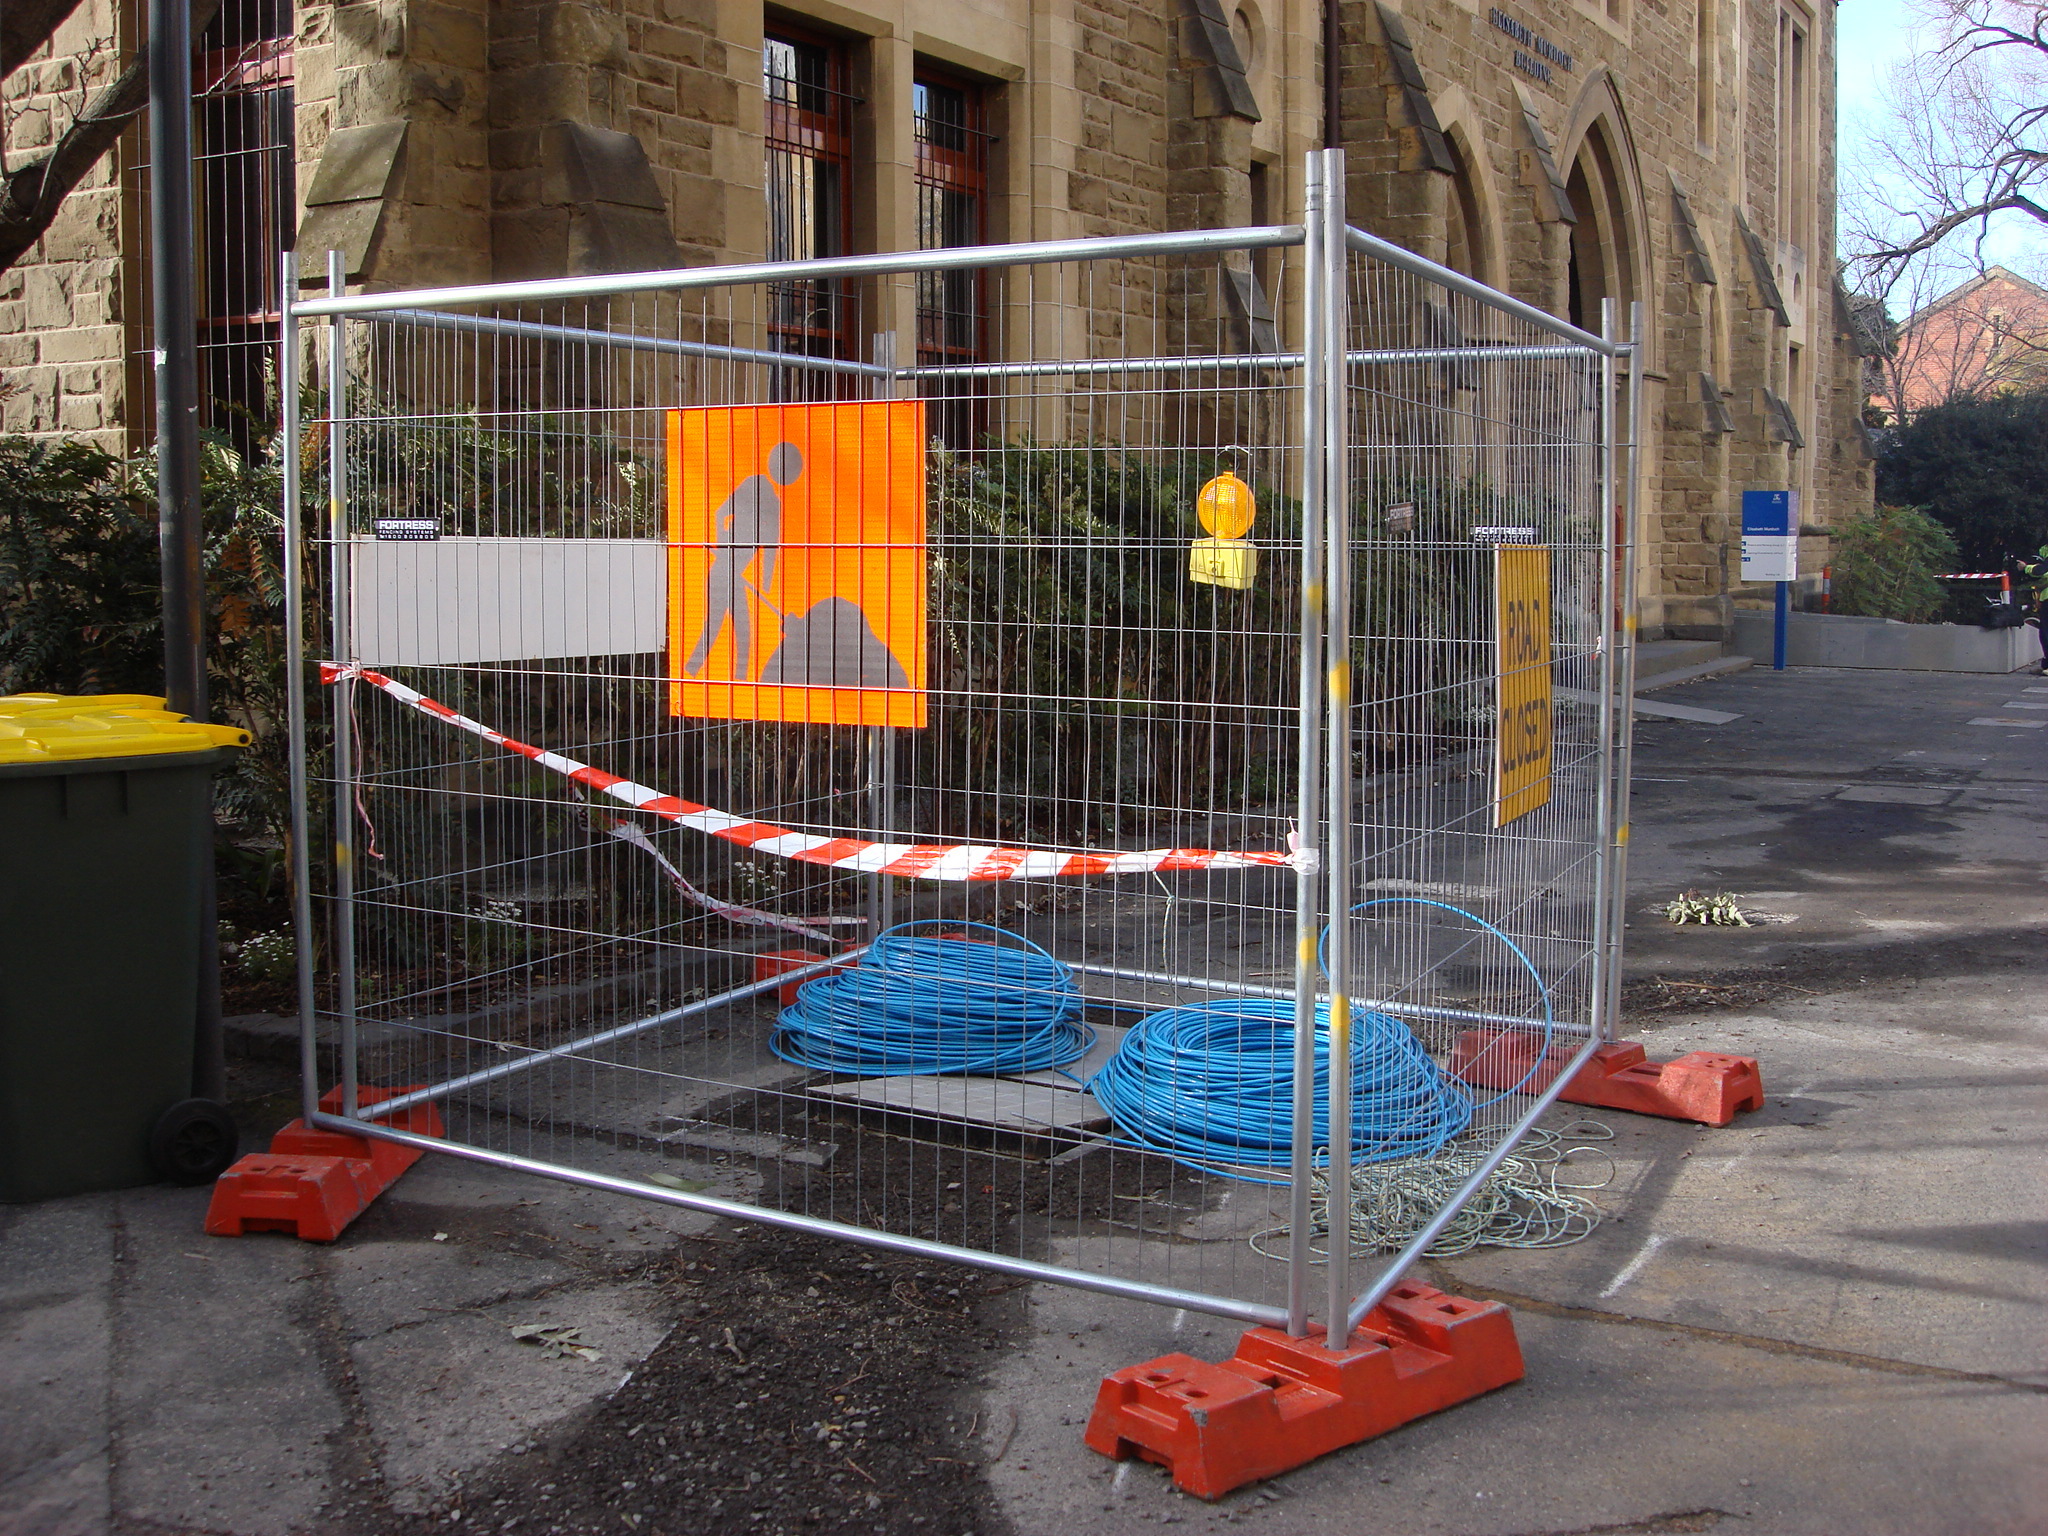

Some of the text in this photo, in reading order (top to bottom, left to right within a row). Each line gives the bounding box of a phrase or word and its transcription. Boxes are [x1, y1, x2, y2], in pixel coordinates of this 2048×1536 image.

[379, 520, 434, 530] FORTRESS
[1475, 526, 1534, 535] FORTRESS
[1507, 599, 1540, 667] ROAD
[1502, 697, 1547, 775] CLOSED
